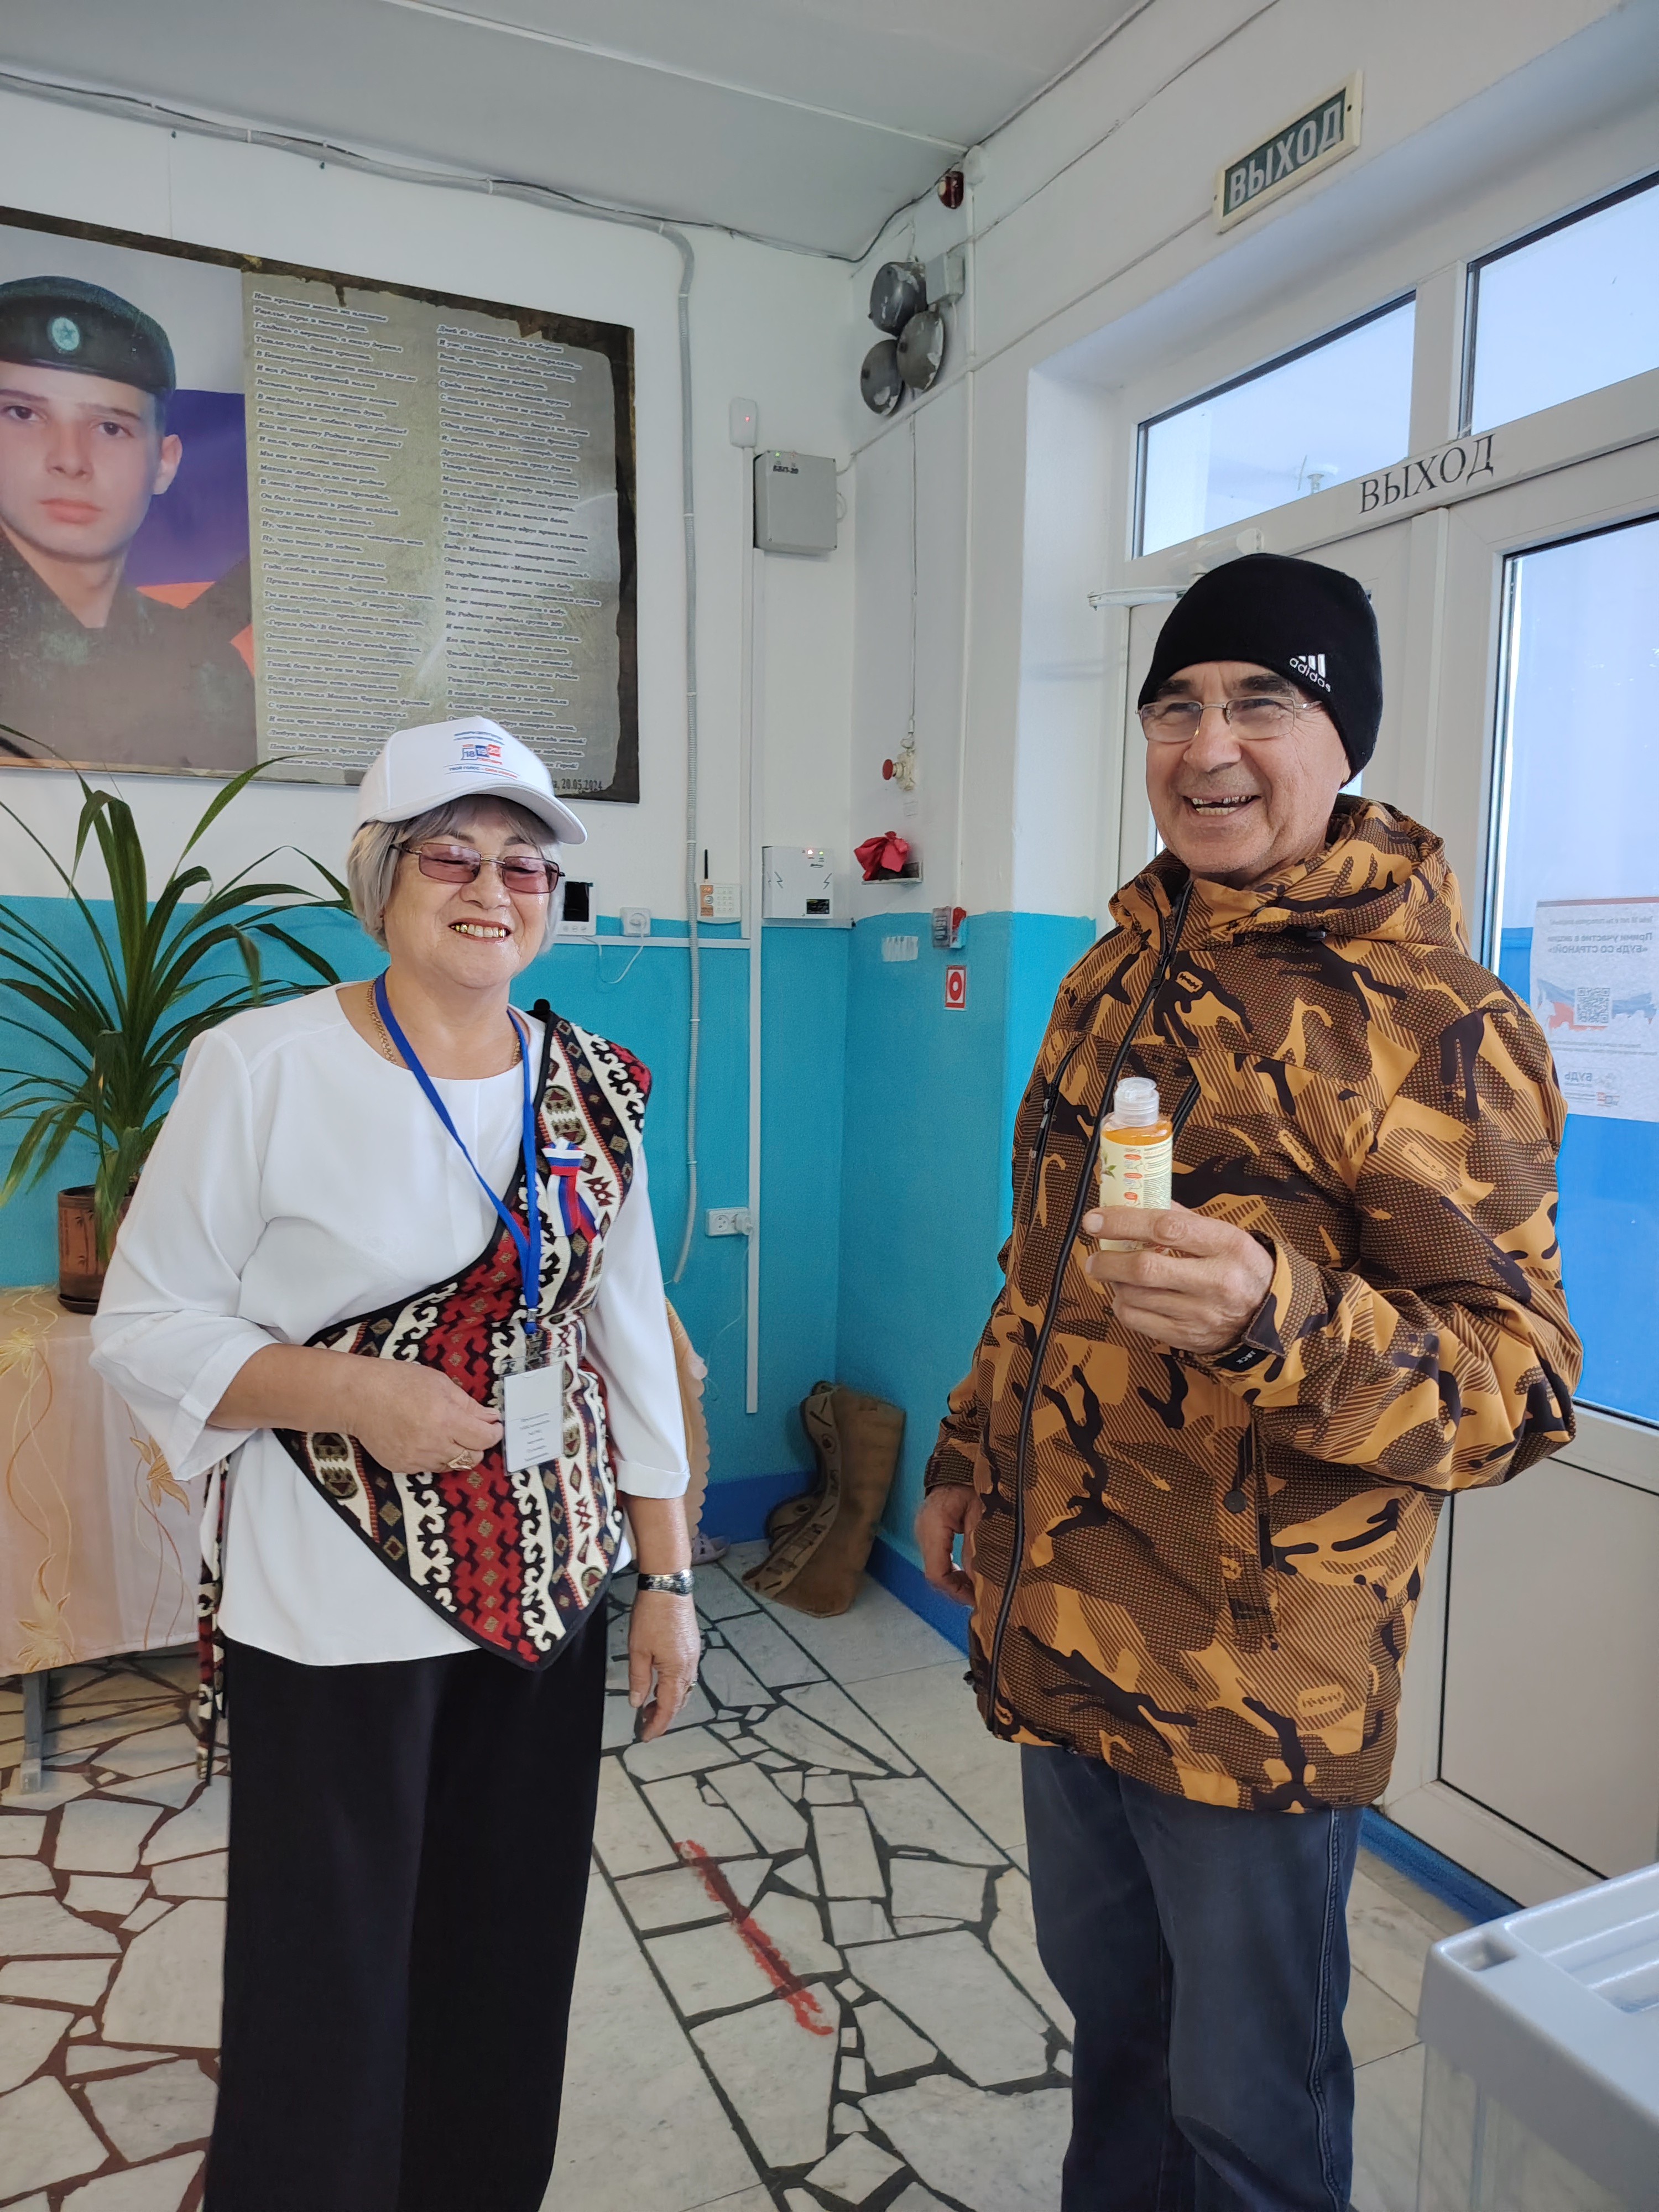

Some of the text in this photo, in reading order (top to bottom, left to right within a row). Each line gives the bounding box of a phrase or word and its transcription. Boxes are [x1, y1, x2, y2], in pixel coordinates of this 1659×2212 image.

[1229, 100, 1343, 210] ВЫХОД
[1359, 434, 1496, 515] ВЫХОД
[1289, 657, 1332, 692] adidas
[561, 778, 602, 791] 20.05.2024
